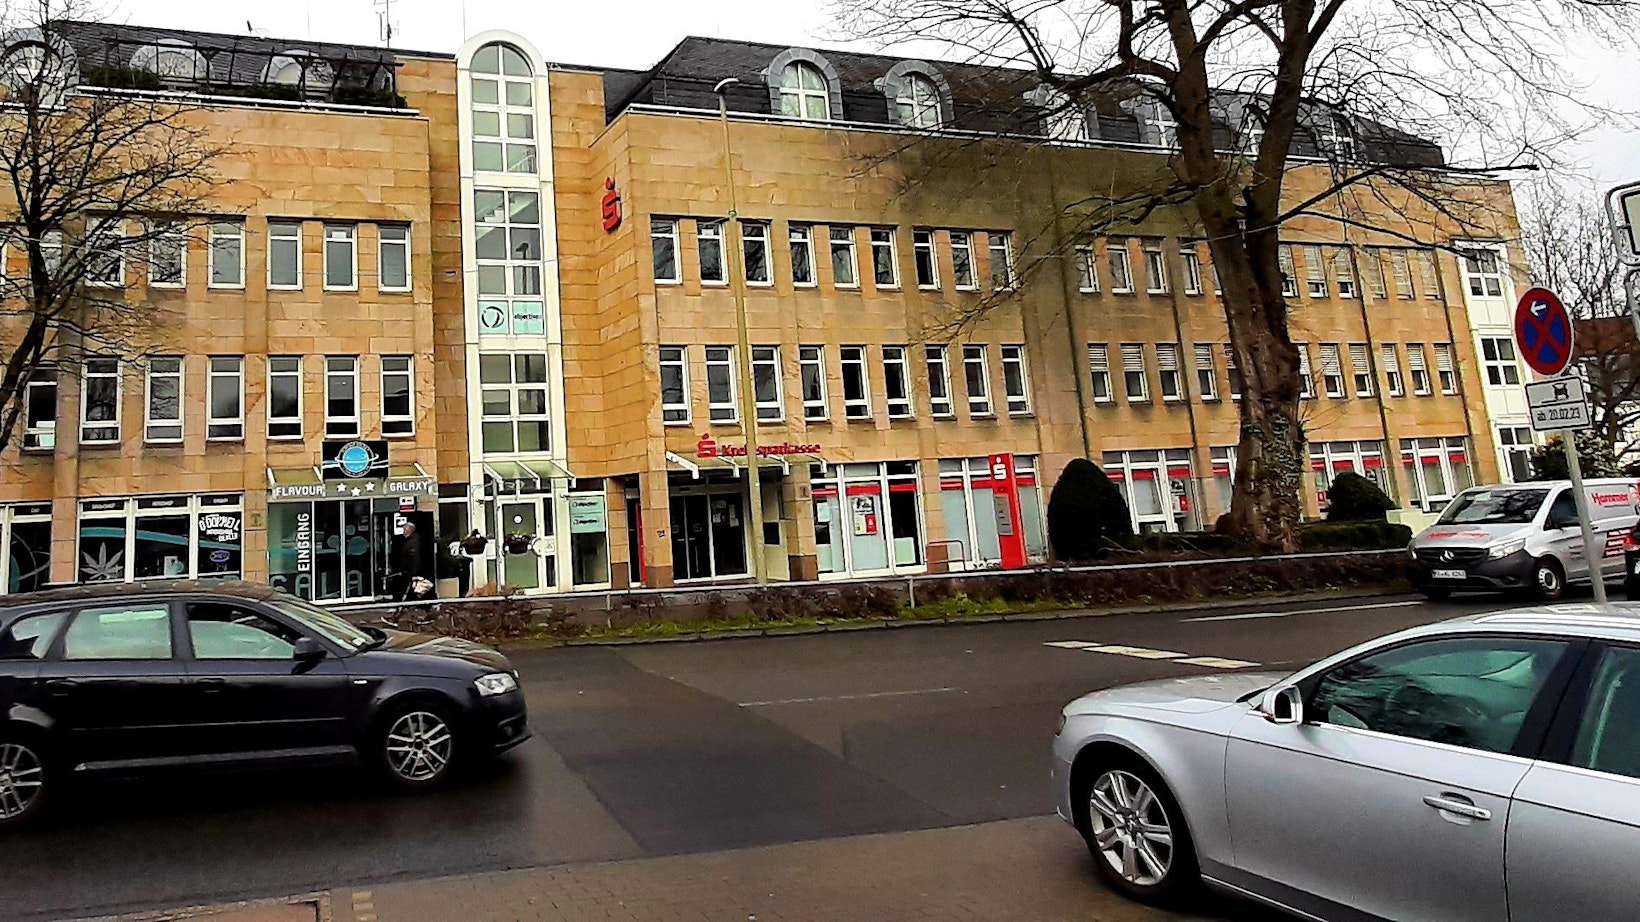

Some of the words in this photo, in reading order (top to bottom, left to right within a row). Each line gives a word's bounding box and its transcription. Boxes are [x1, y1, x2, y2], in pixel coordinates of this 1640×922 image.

[276, 485, 322, 497] FLAVOUR
[390, 481, 428, 492] GALAXY
[297, 513, 310, 572] EINGANG
